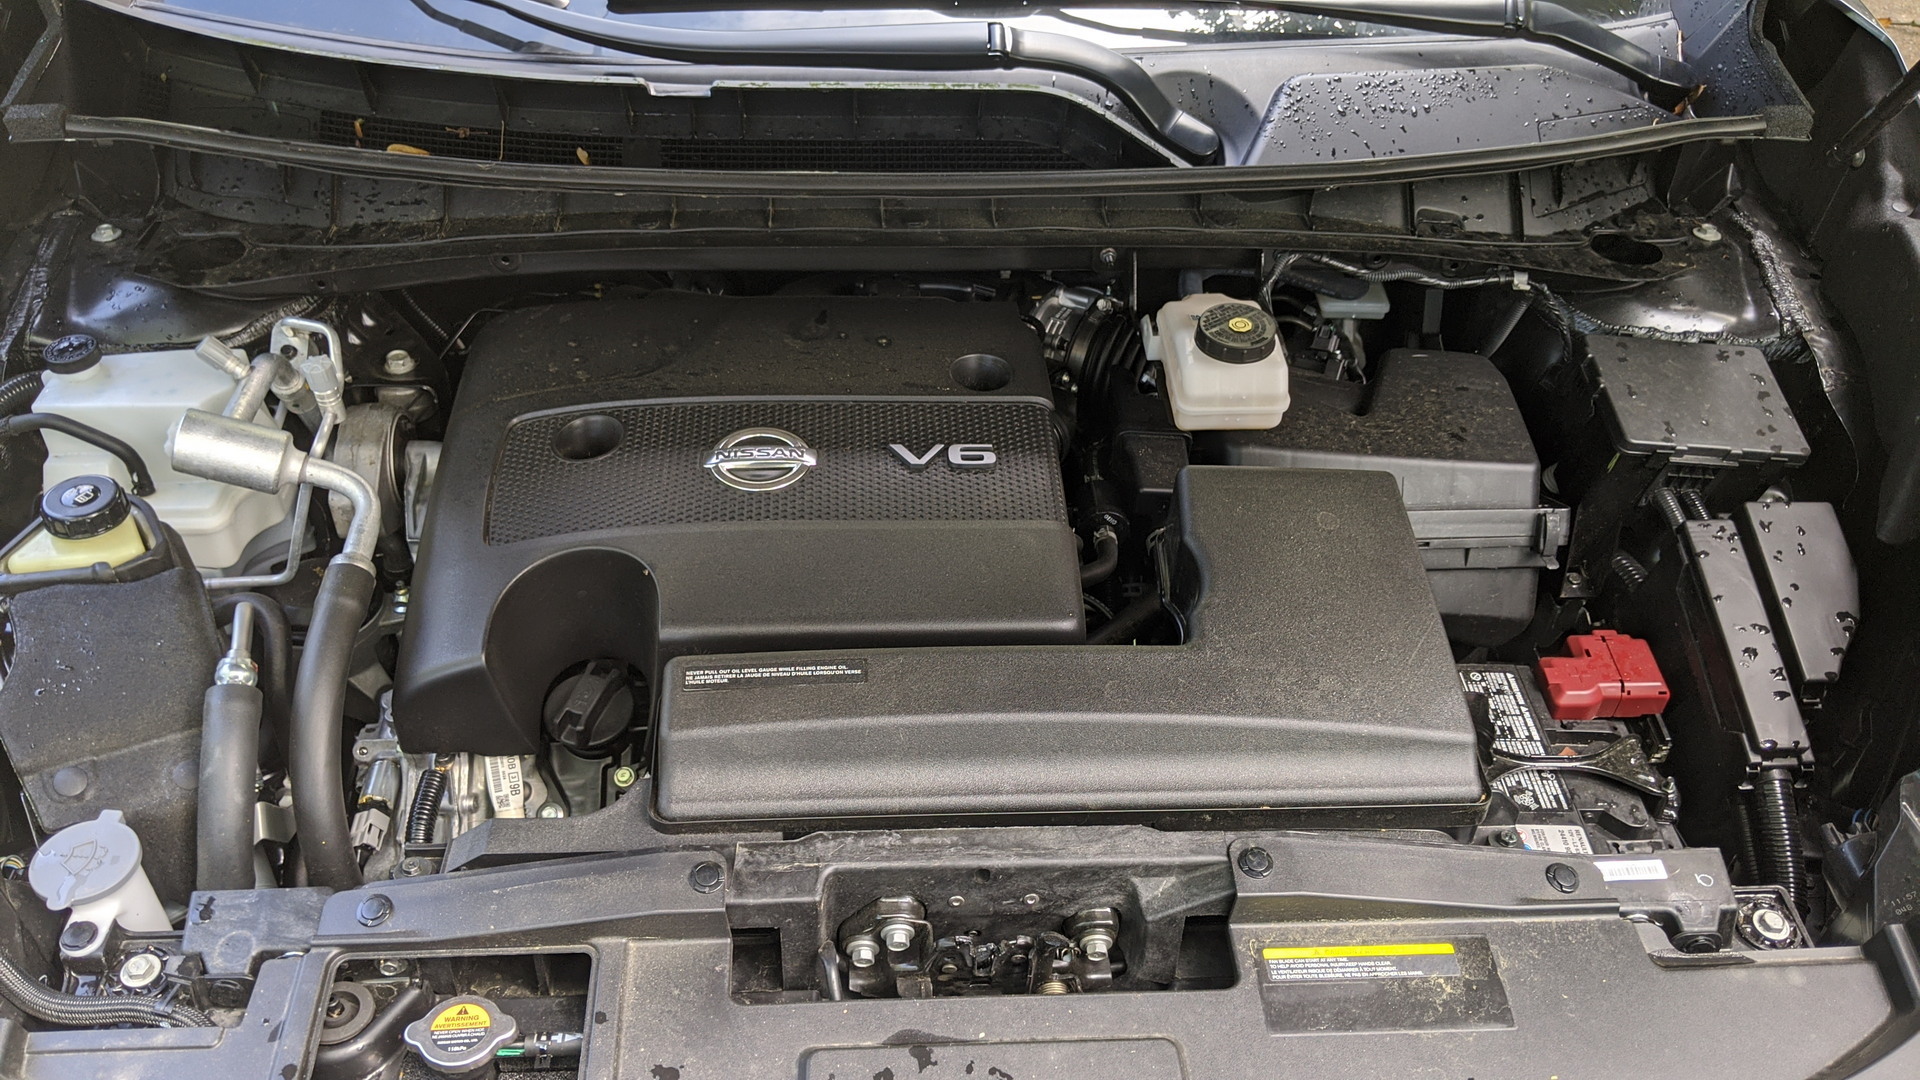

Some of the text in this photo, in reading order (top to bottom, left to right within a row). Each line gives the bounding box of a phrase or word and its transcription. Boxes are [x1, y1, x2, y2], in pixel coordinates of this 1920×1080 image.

[714, 446, 805, 460] NISSAN
[889, 443, 997, 468] V6
[510, 784, 520, 796] 9B
